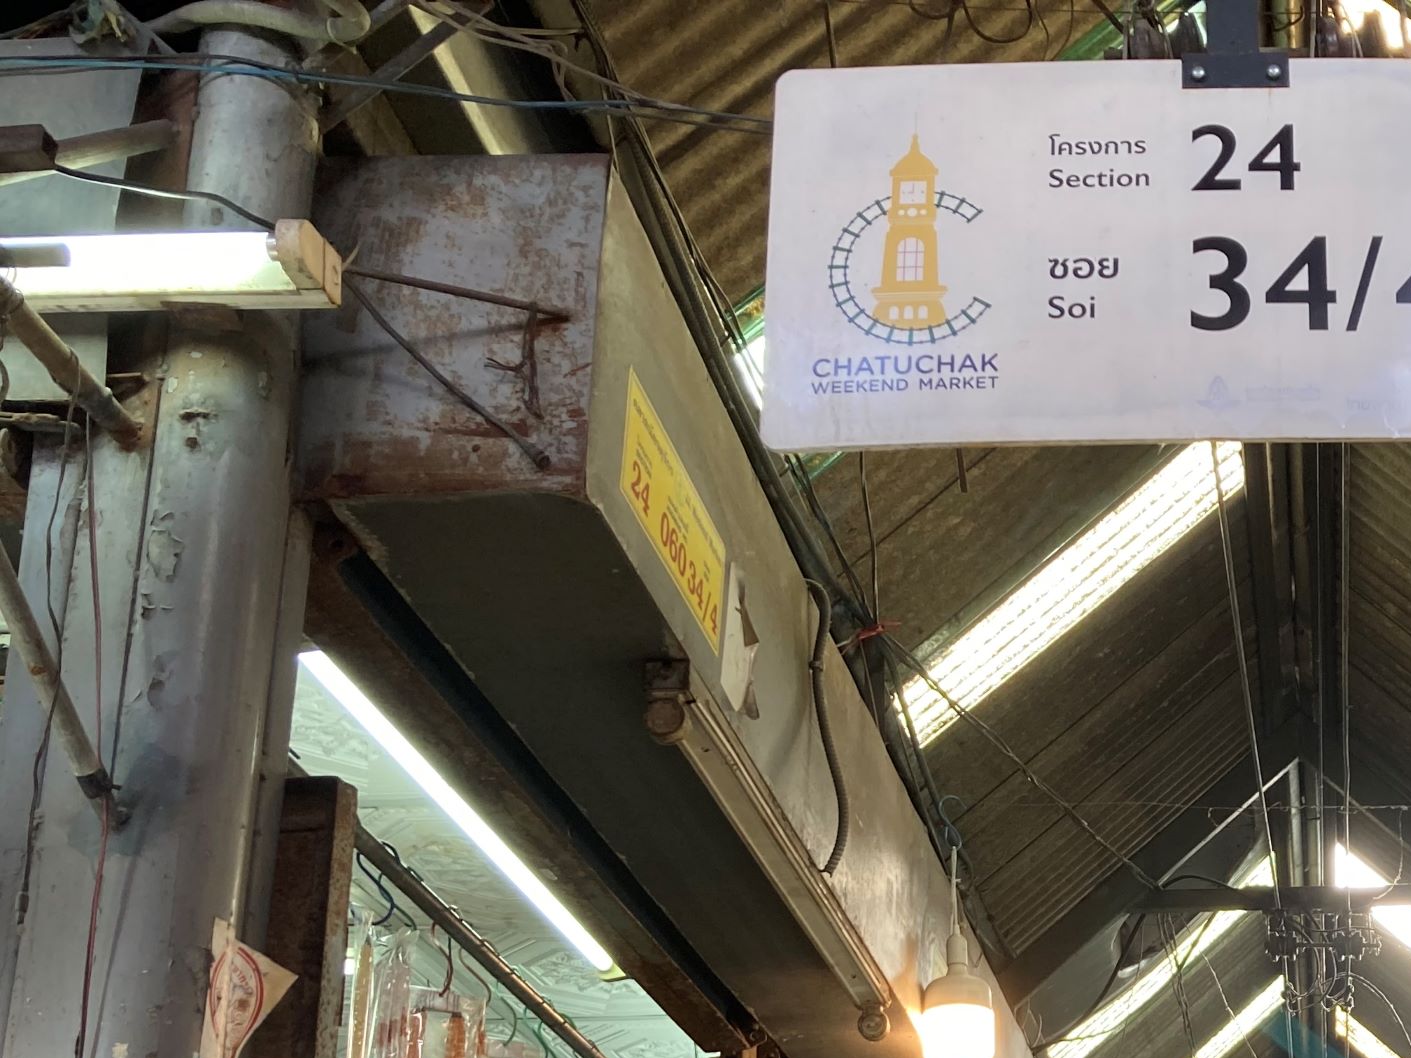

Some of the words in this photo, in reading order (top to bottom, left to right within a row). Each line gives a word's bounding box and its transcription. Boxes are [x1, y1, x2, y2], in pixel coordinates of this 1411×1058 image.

[1048, 133, 1147, 156] โครงการ
[1190, 123, 1301, 191] 24
[1048, 168, 1151, 188] Section
[1048, 256, 1120, 280] ซอย
[1047, 295, 1097, 319] Soi
[812, 353, 999, 378] CHATUCHAK
[811, 378, 909, 395] WEEKEND
[918, 375, 999, 391] MARKET
[630, 459, 651, 519] 24
[659, 511, 688, 577] 060
